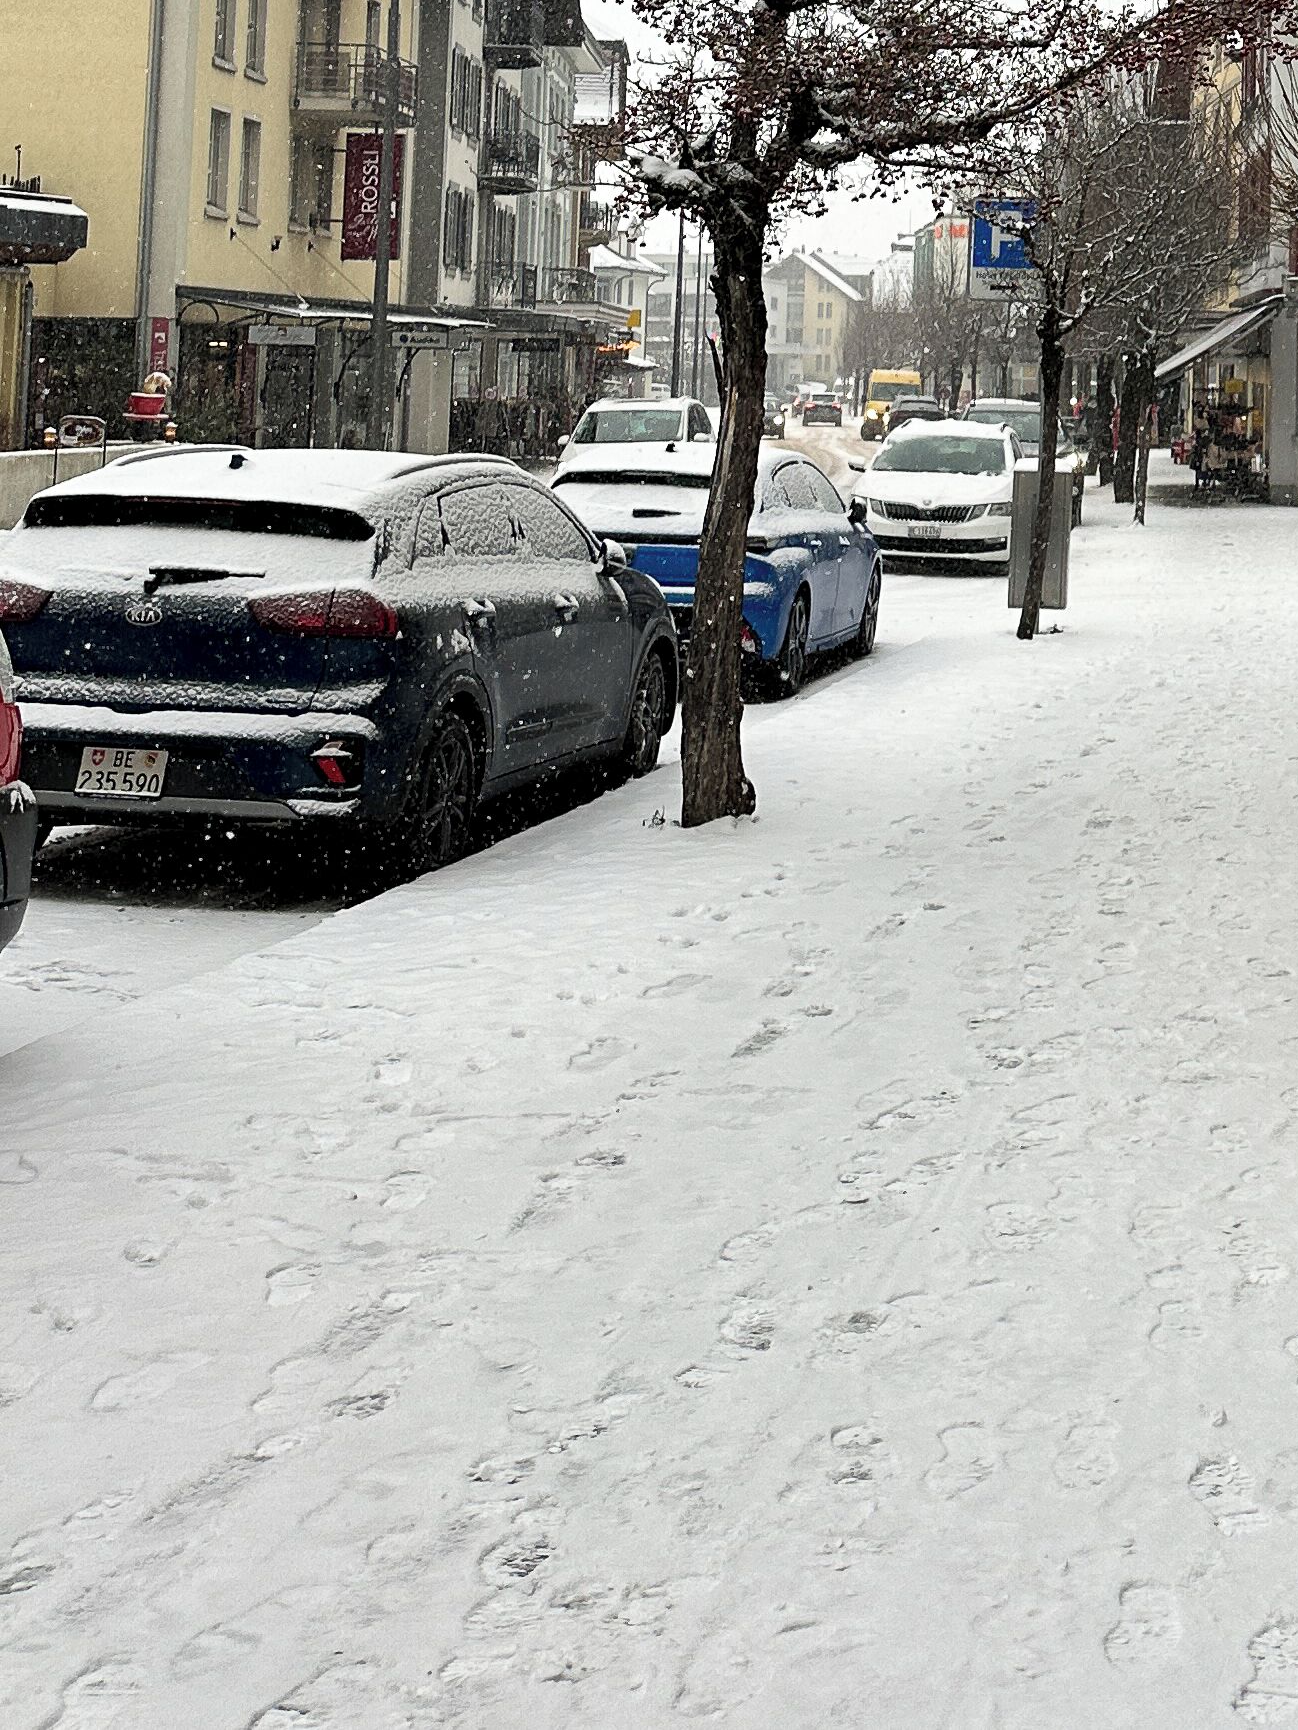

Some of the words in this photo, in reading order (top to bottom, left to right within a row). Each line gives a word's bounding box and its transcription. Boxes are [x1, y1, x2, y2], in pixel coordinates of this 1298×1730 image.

[359, 150, 380, 214] RÖSSLI
[130, 609, 156, 622] KIA
[113, 750, 136, 768] BE
